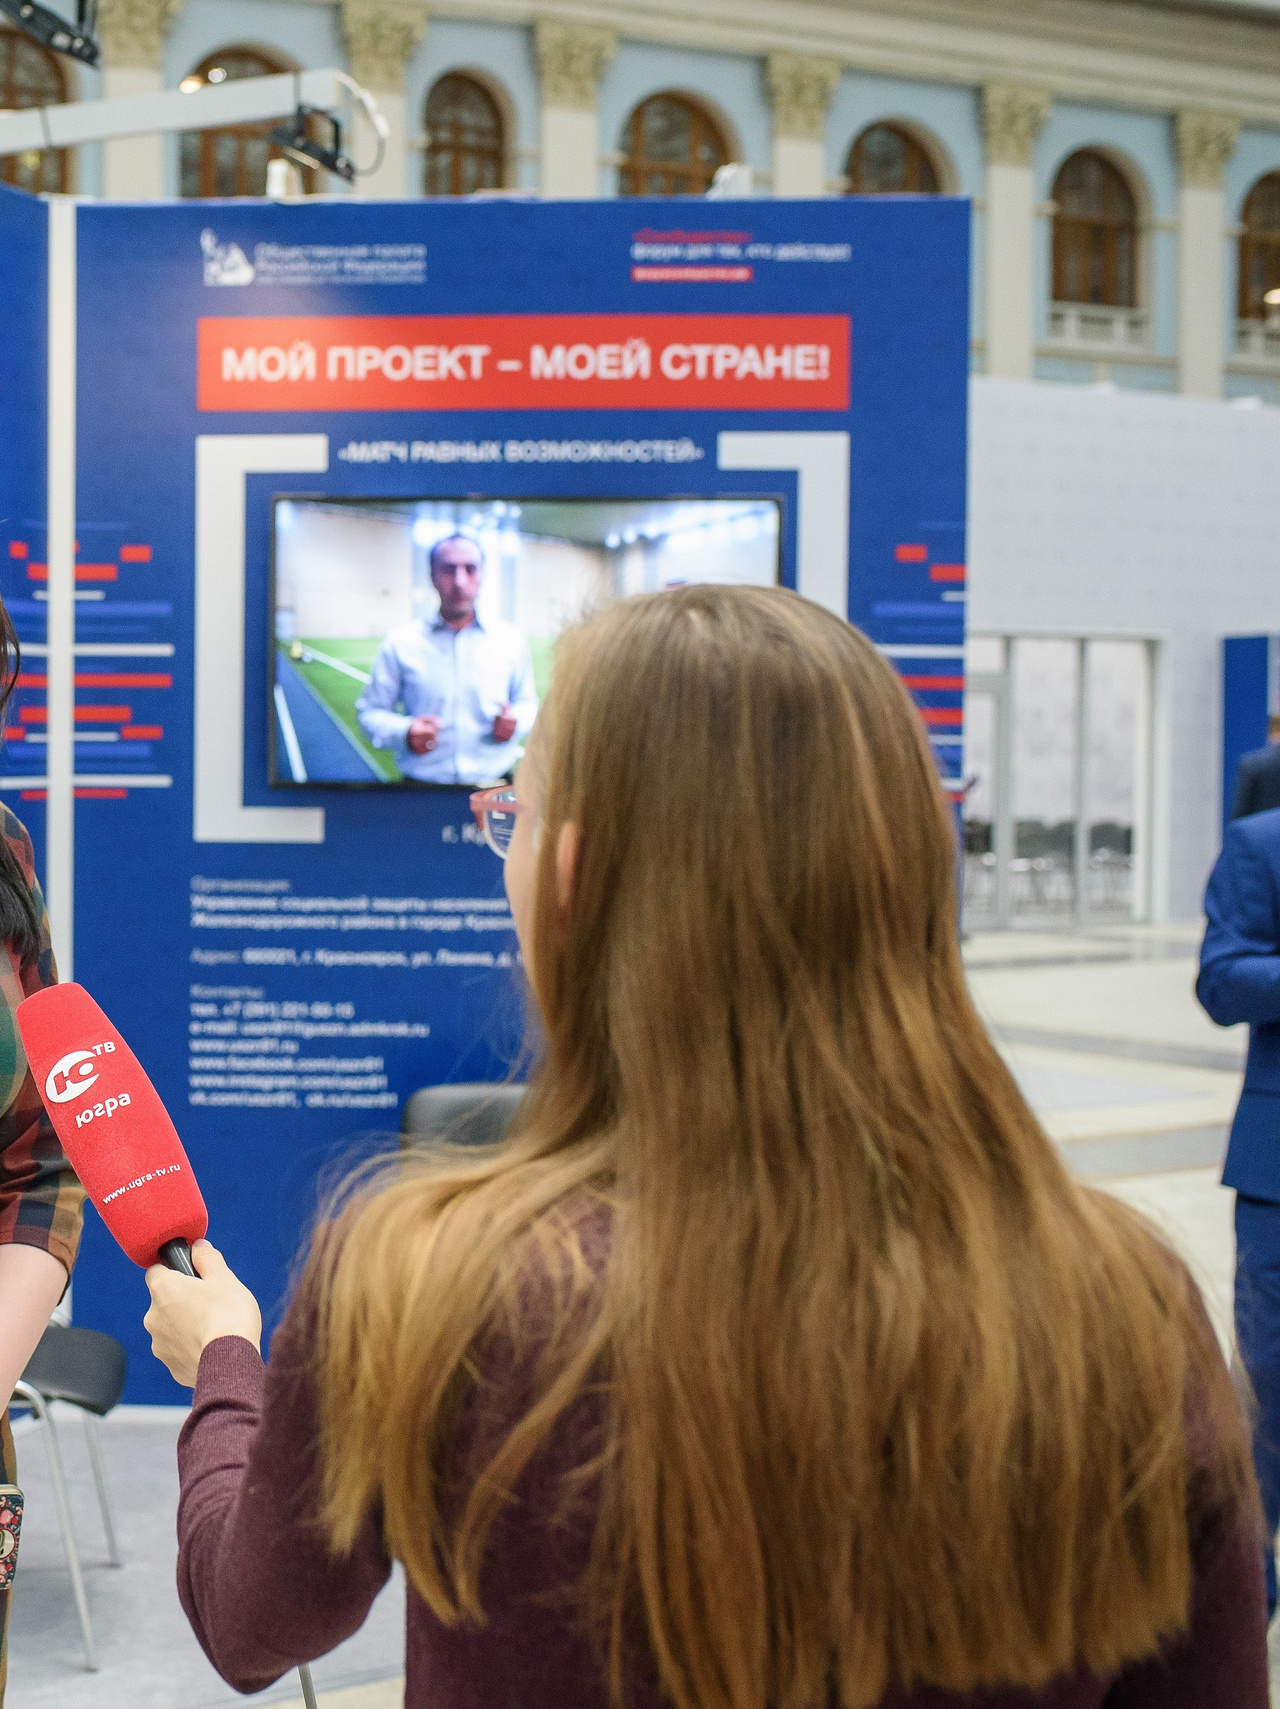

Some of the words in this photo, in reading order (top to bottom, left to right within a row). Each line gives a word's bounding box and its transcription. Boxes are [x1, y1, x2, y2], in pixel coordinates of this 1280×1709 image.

[221, 339, 317, 383] МОЙ
[326, 344, 492, 382] ПРОЕКТ
[529, 336, 652, 381] МОЕЙ
[659, 343, 830, 381] СТРАНЕ!
[337, 439, 409, 463] «МАТЧ
[410, 440, 502, 463] РАВНЫХ
[503, 437, 705, 463] ВОЗМОЖНОСТЕЙ»
[75, 1093, 131, 1129] югра
[102, 1163, 181, 1204] www.ugra-tv.ru
